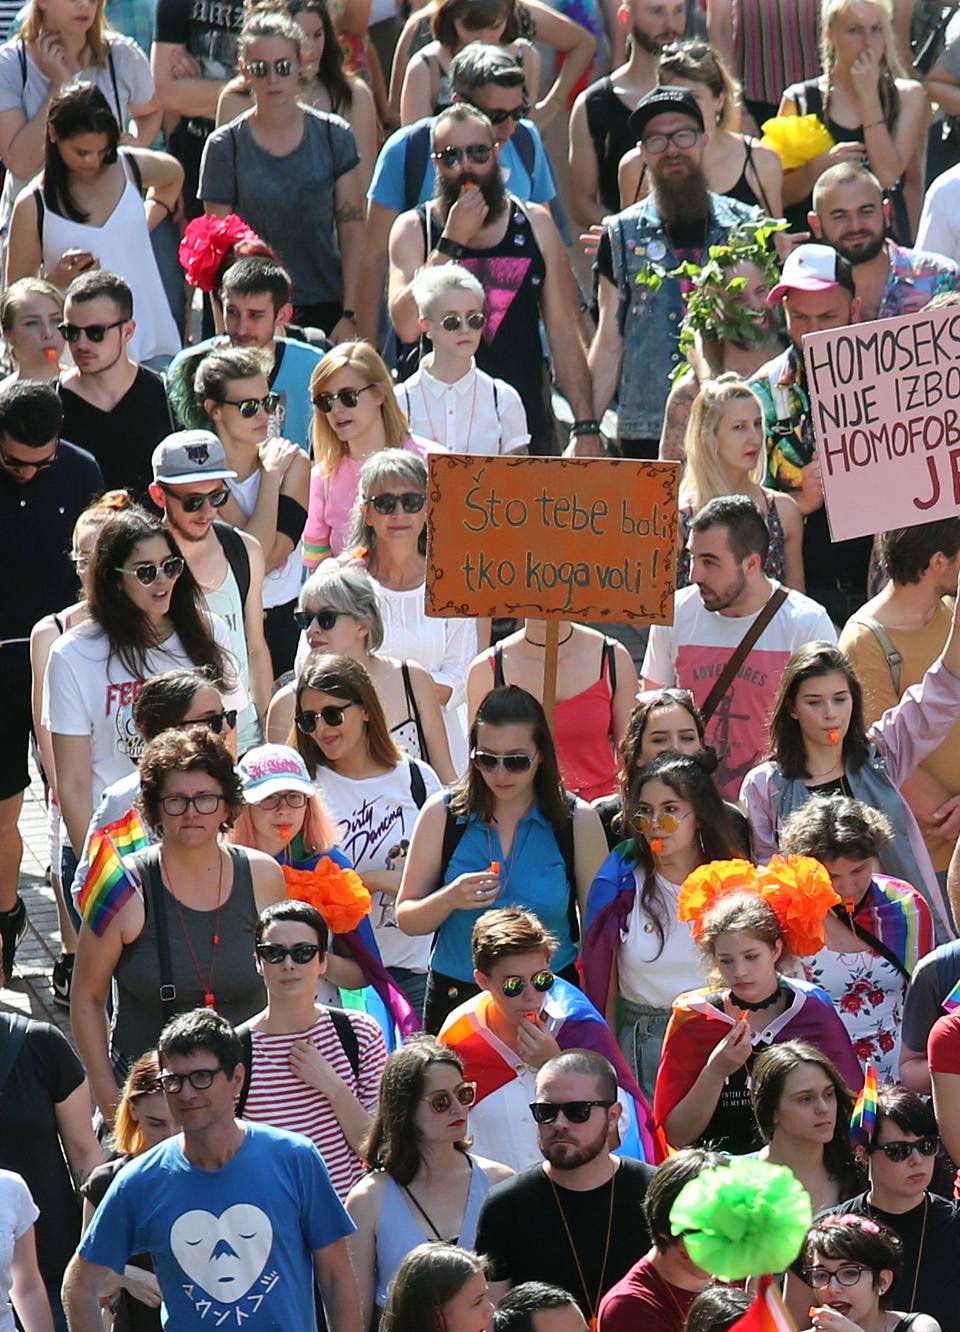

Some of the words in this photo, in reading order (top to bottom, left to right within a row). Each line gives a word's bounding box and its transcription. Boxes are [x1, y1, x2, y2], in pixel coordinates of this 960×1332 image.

[818, 385, 879, 434] NIJE
[463, 467, 528, 531] Što
[535, 488, 609, 535] tebe
[621, 499, 668, 538] boli
[462, 552, 517, 592] tko
[526, 551, 590, 610] koga
[343, 805, 406, 870] Dancing
[182, 1271, 280, 1326] マウントフジ
